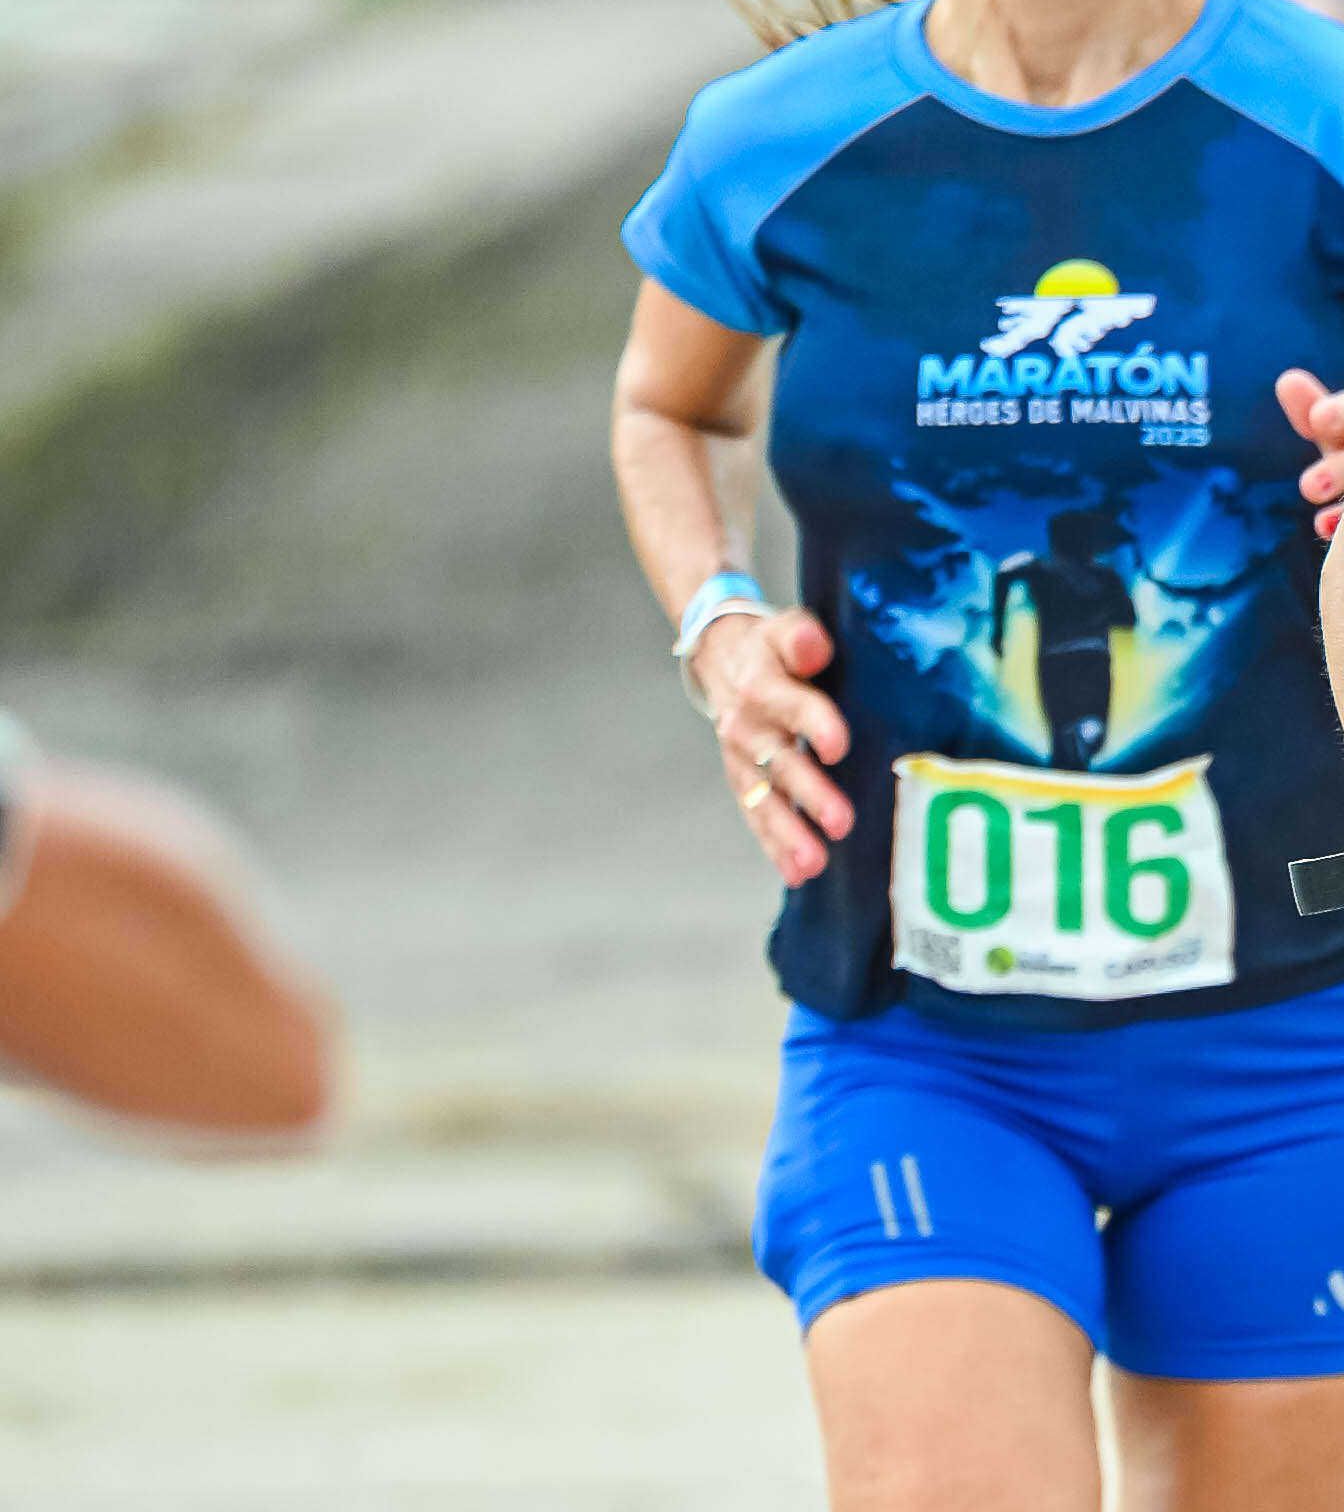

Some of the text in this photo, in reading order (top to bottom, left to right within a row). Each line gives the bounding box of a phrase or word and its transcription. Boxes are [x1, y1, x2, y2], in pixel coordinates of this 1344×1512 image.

[917, 340, 1210, 398] MARATÓN
[1028, 397, 1063, 424] DE
[925, 789, 1191, 940] 016
